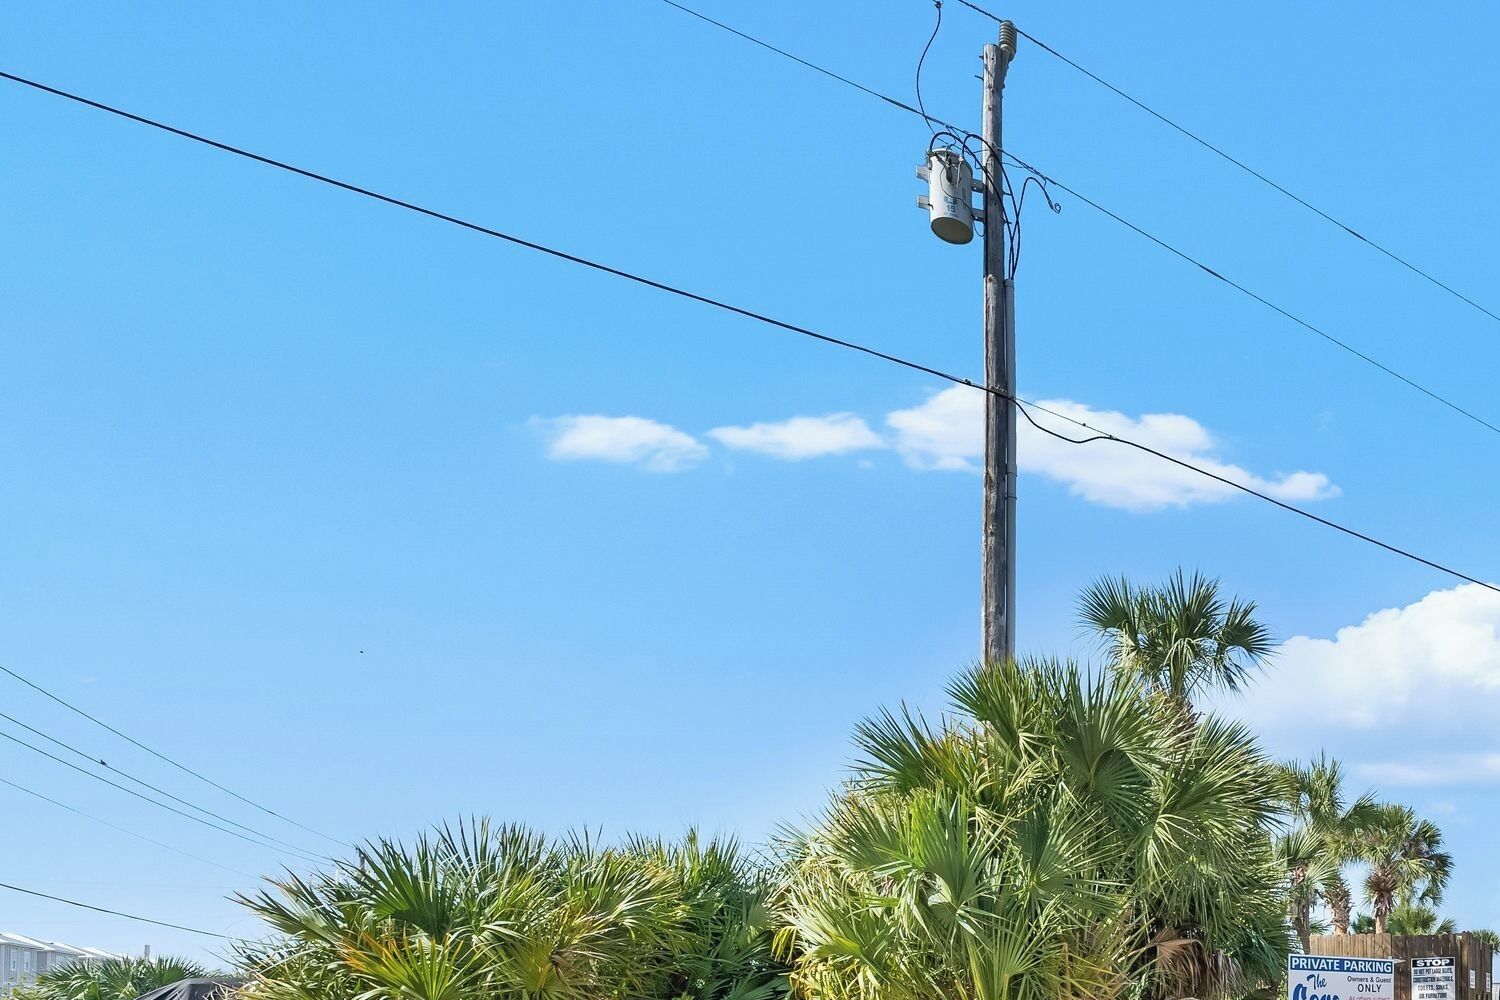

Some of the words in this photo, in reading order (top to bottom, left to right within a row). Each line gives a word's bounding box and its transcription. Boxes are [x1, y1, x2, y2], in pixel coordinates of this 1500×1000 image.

[1291, 957, 1340, 970] PRIVATE
[1343, 960, 1392, 973] PARKING
[1416, 959, 1450, 967] STOP
[1306, 973, 1327, 990] The
[1347, 975, 1369, 983] Owners
[1357, 984, 1382, 992] ONLY
